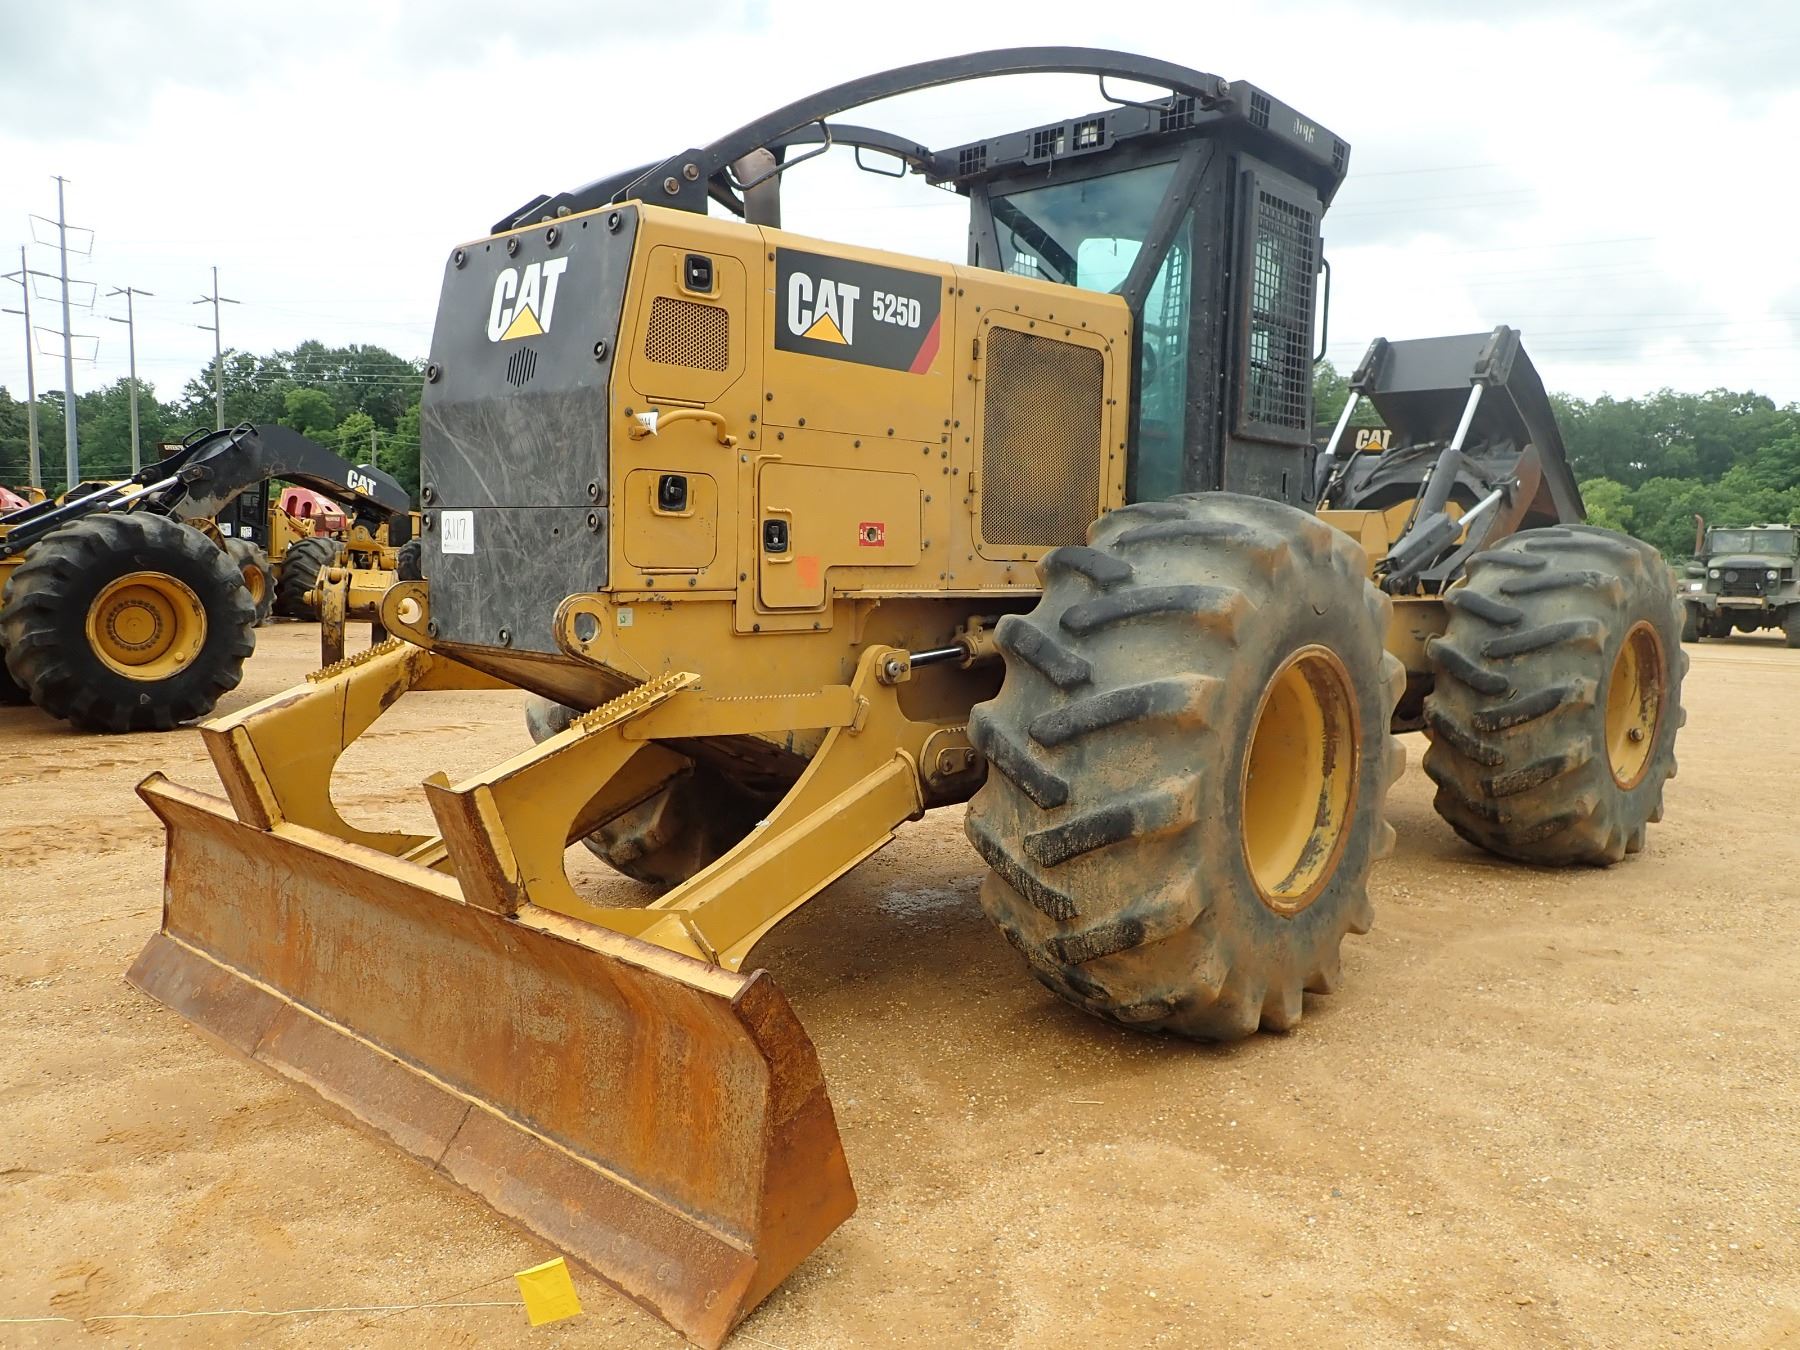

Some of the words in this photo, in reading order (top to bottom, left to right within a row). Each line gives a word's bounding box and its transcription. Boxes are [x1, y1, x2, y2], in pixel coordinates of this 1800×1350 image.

[488, 256, 569, 342] CAT
[788, 271, 860, 346] CAT
[872, 290, 921, 329] 525D
[1355, 428, 1393, 451] CAT
[347, 469, 377, 496] CAT
